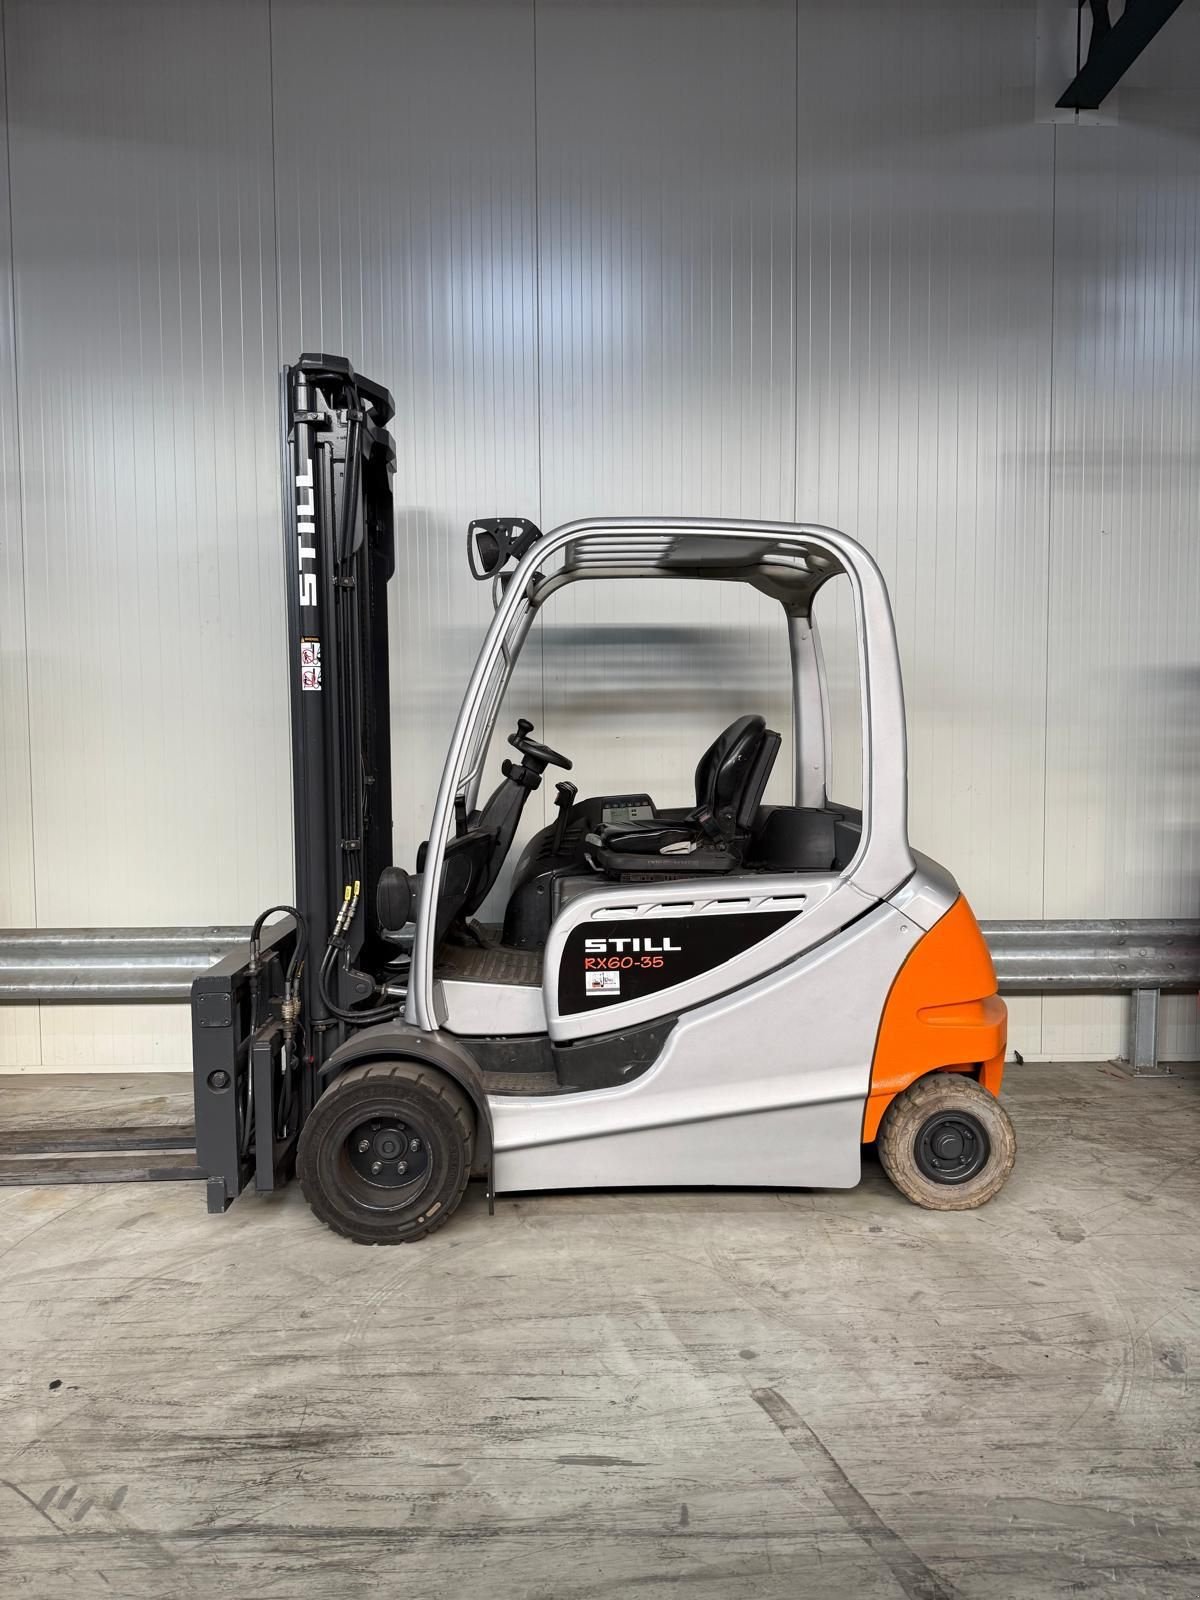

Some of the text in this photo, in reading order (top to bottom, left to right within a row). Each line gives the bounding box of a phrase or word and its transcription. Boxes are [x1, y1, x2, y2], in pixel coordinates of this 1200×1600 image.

[295, 458, 318, 607] STILL
[584, 937, 682, 953] STILL
[584, 955, 665, 970] RX60-35
